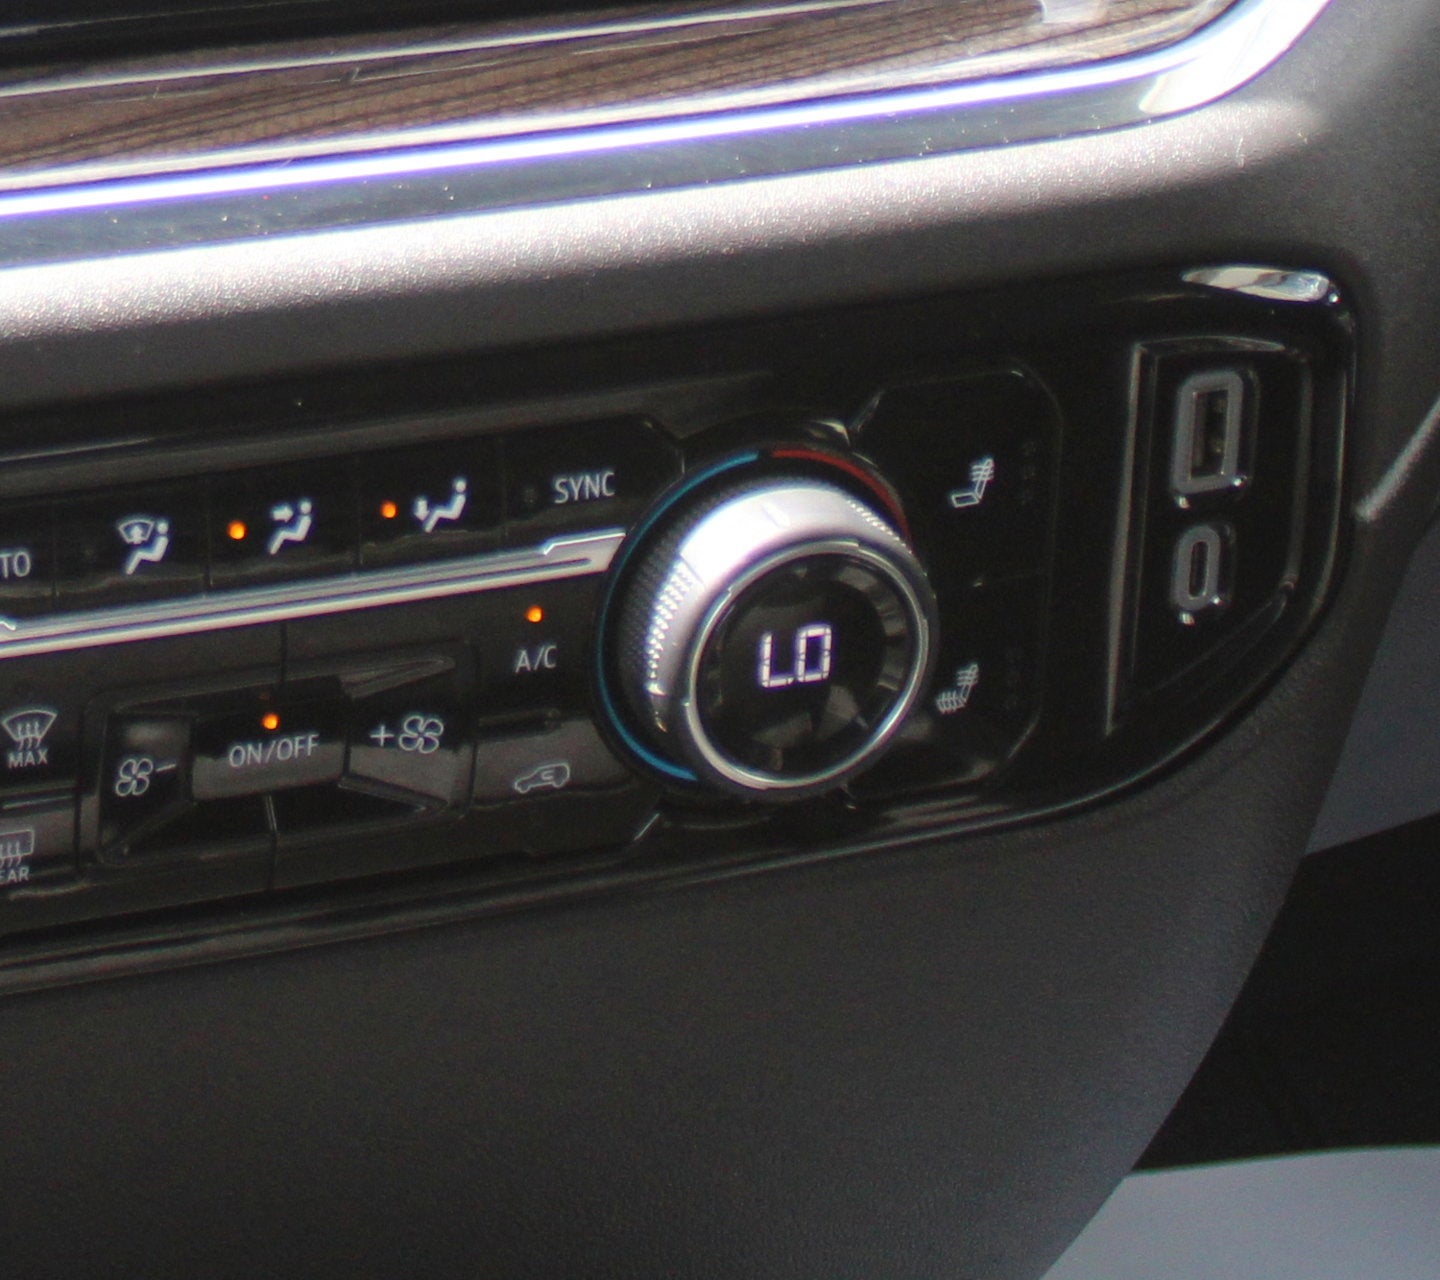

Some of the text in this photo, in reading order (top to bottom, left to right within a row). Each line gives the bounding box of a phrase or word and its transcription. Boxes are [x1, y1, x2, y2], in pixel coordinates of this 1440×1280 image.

[553, 470, 615, 504] SYNC
[514, 644, 558, 673] A/C
[758, 623, 833, 689] LO
[7, 747, 50, 769] MAX
[227, 733, 320, 770] ON/OFF
